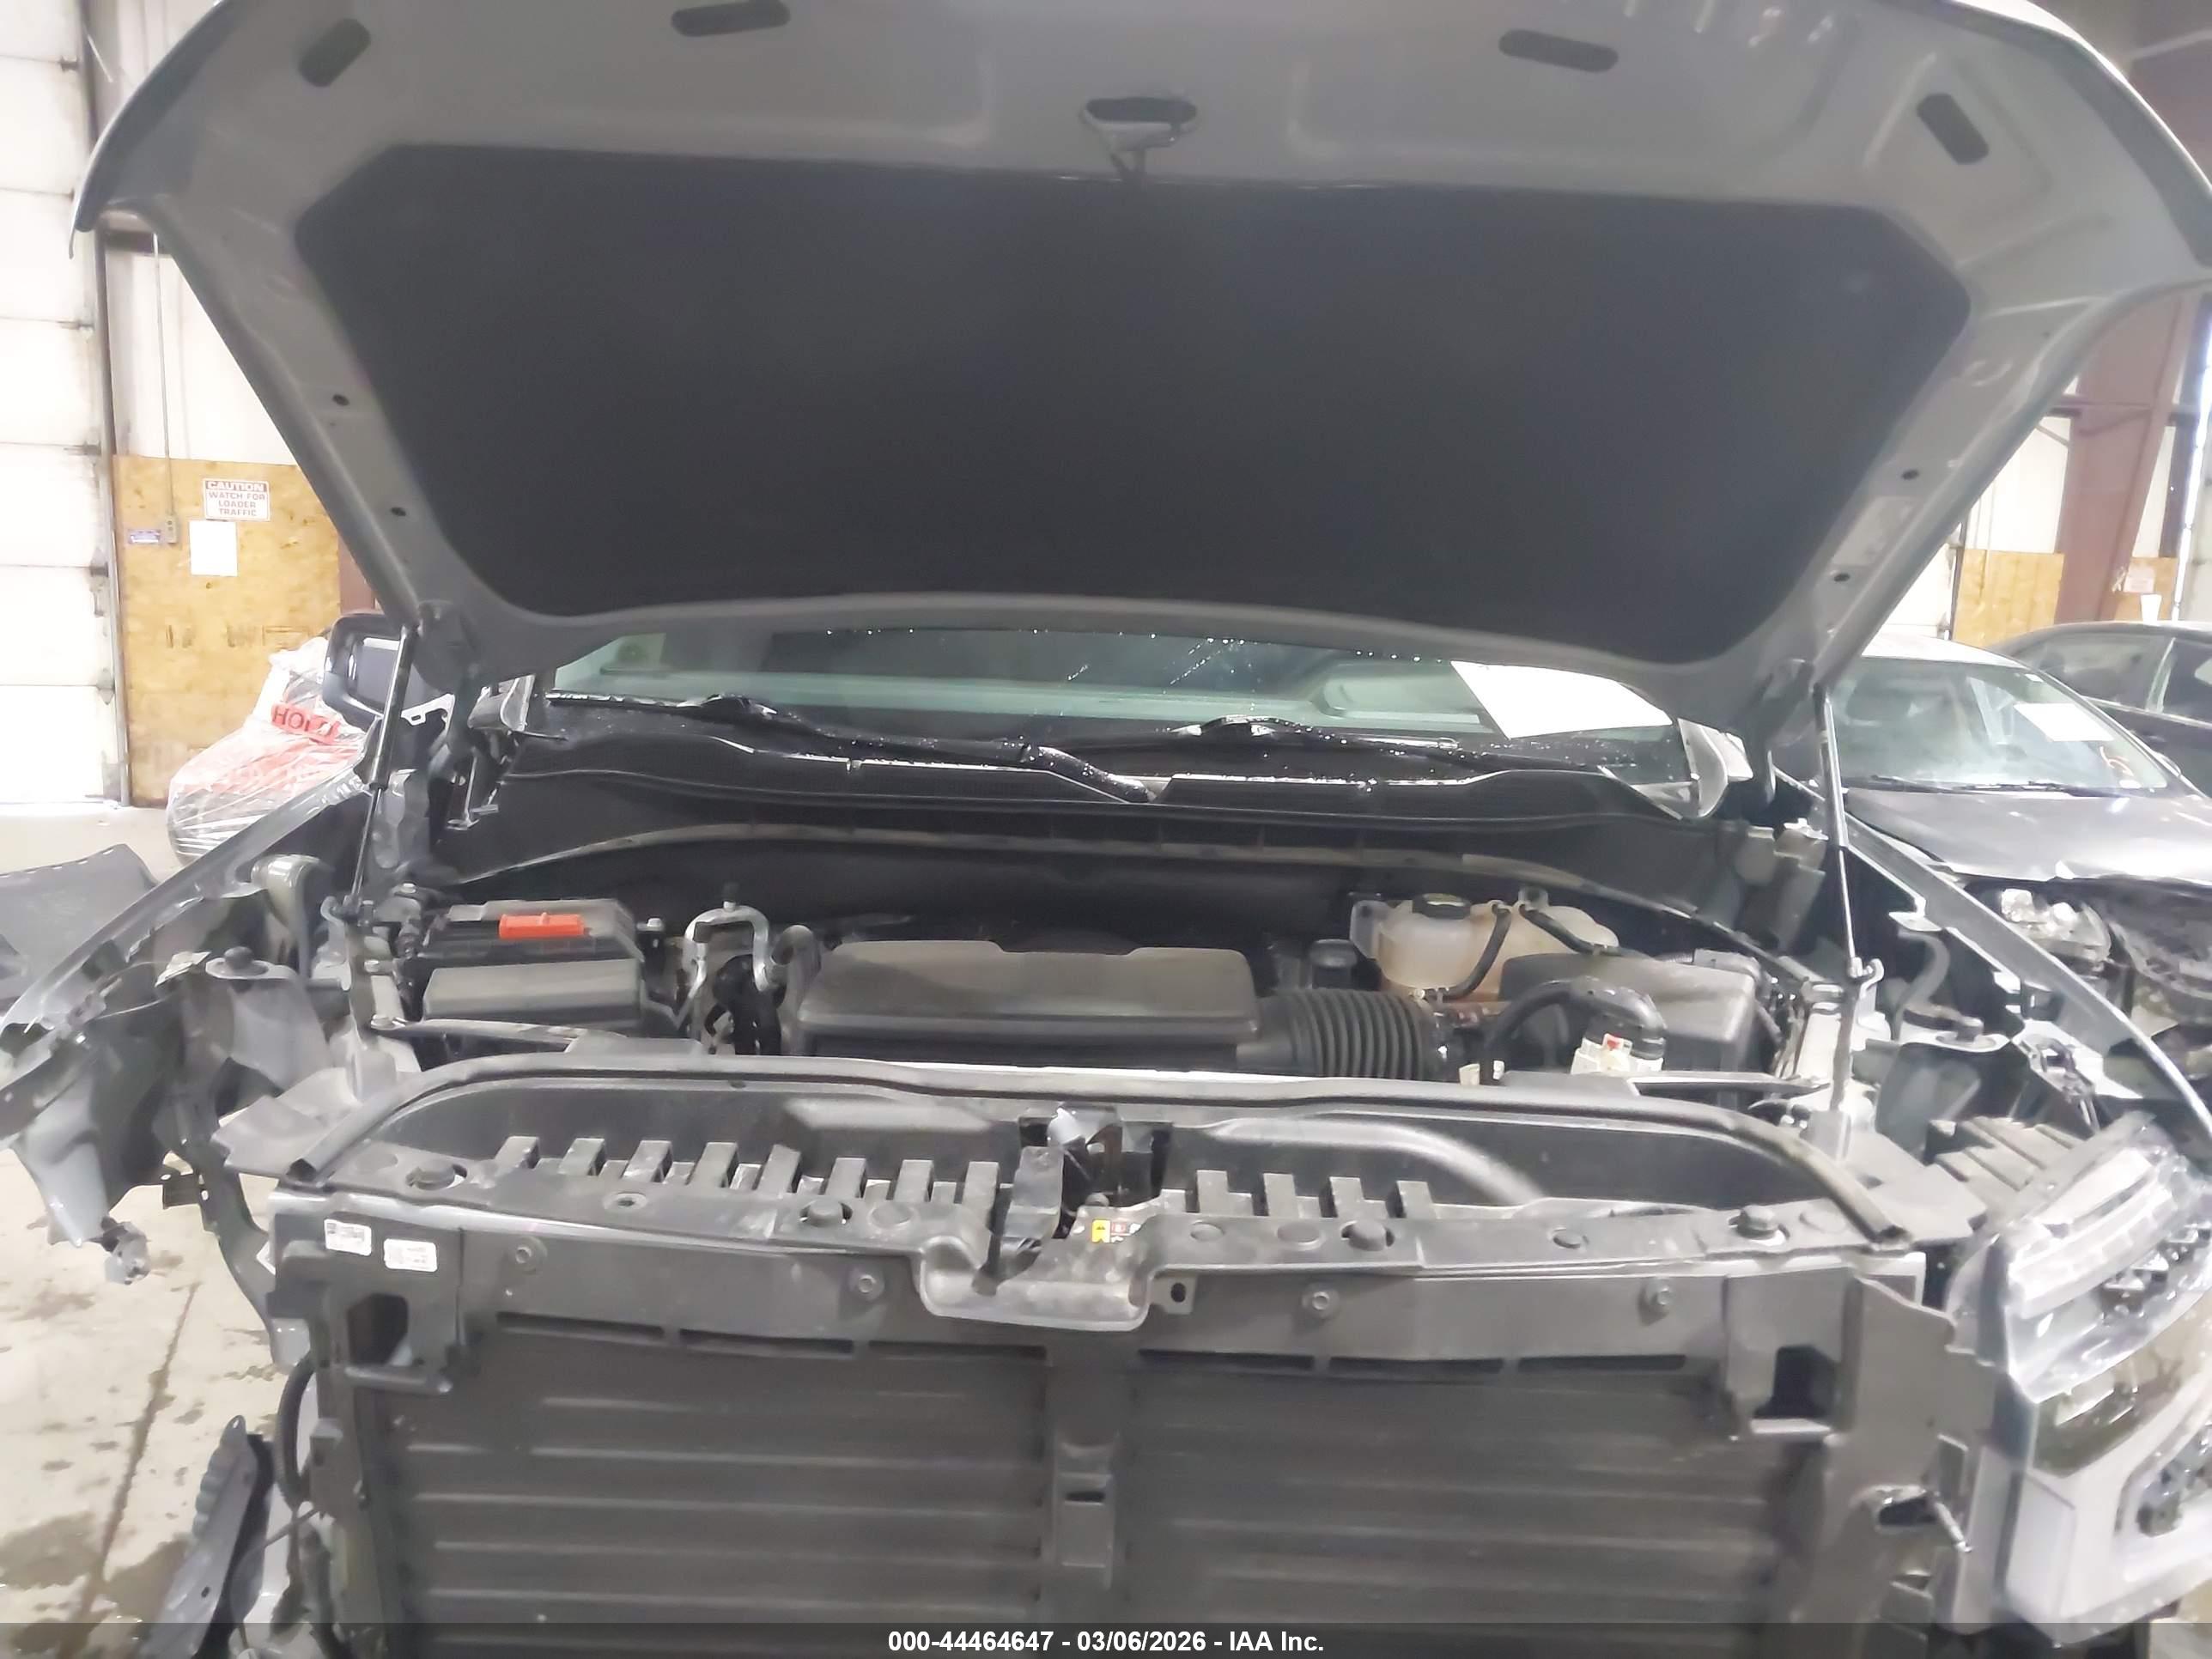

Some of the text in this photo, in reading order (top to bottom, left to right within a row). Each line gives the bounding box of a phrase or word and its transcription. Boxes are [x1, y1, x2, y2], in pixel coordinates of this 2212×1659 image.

[207, 481, 264, 492] CAUTION
[209, 491, 243, 500] WATCH
[218, 500, 257, 508] LOADER
[219, 508, 257, 517] TRAFFIC
